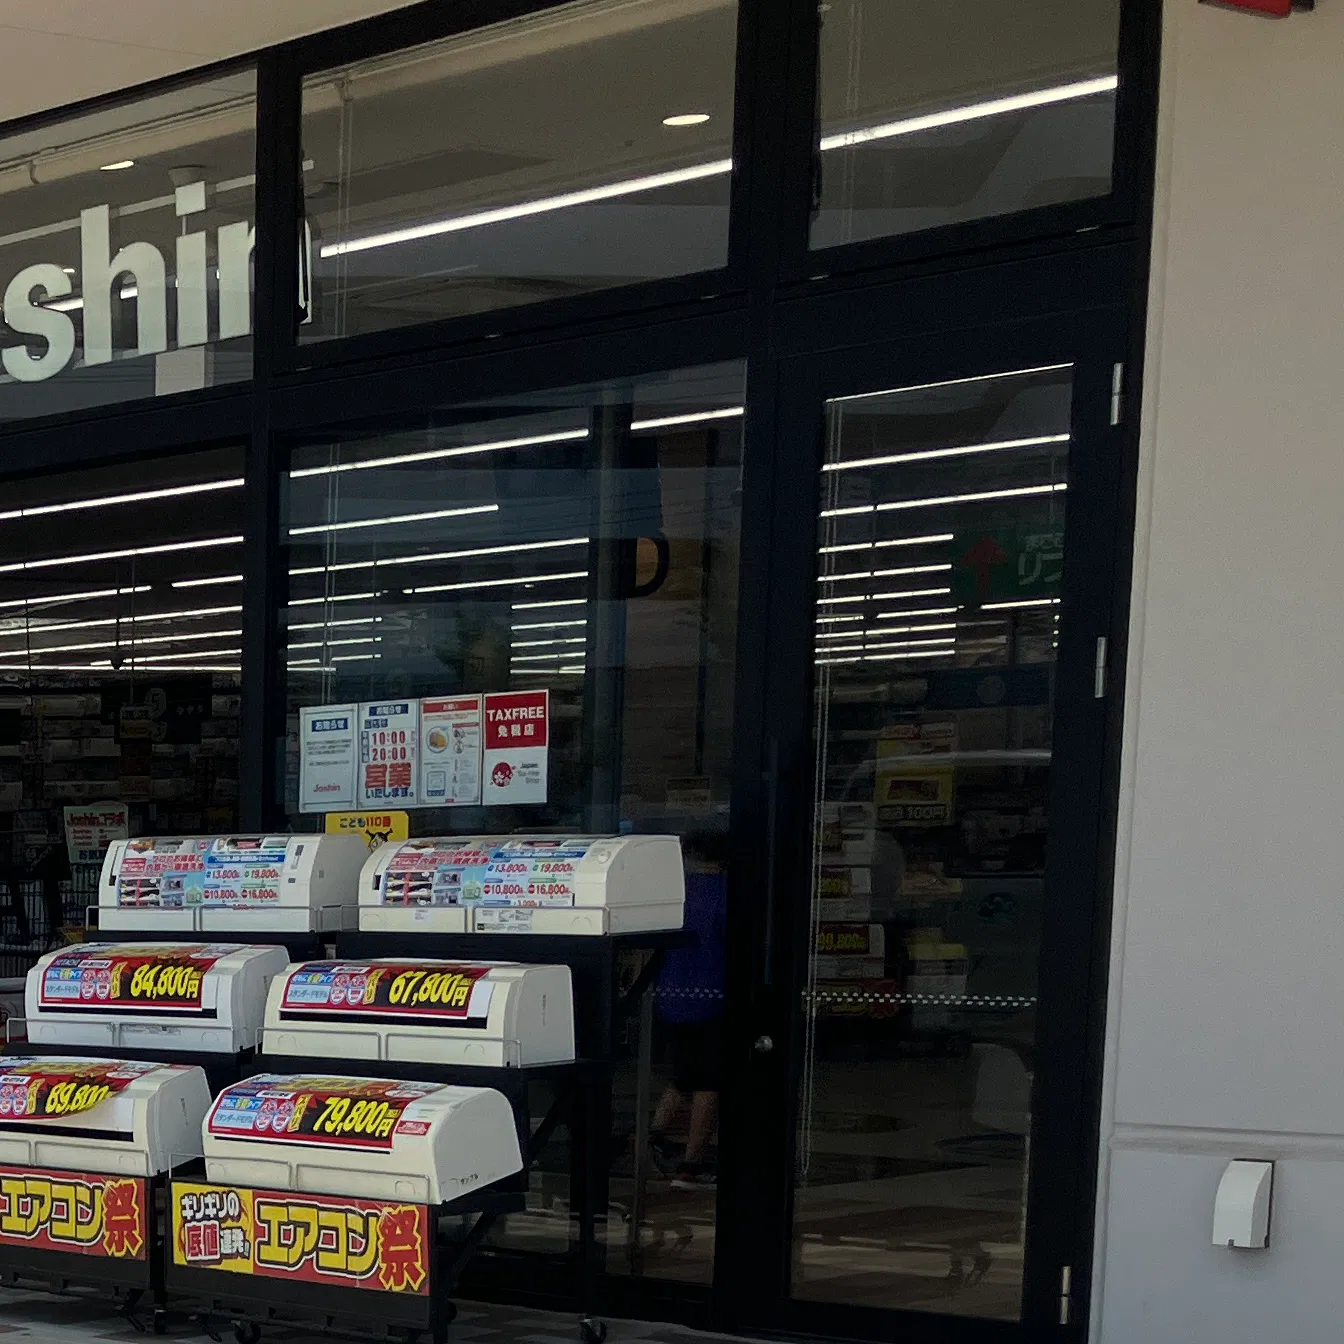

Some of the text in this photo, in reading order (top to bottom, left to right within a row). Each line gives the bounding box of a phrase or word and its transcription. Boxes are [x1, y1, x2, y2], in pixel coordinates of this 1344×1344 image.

[486, 706, 544, 721] TAXFREE
[372, 731, 406, 745] 10:00
[372, 747, 406, 761] 20:00
[365, 762, 411, 788] 営業
[339, 816, 391, 828] こども110番
[312, 1096, 394, 1137] 79,800円
[181, 1191, 241, 1221] ギリギリの
